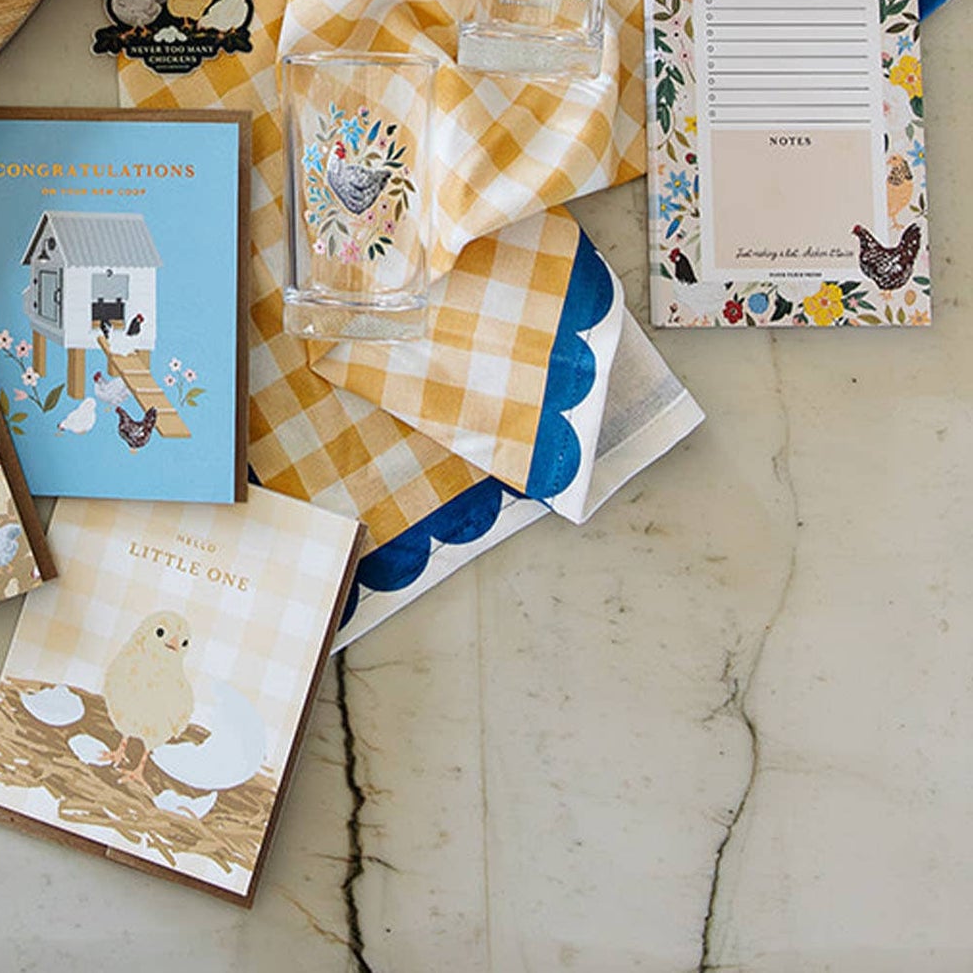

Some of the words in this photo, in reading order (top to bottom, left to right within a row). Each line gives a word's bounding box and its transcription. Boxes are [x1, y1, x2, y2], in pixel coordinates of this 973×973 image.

[131, 46, 161, 54] NEVER
[164, 45, 185, 54] TOO
[187, 45, 214, 53] MANY
[148, 55, 197, 63] CHICKENS
[769, 136, 811, 146] NOTES
[41, 187, 57, 195] ON
[118, 188, 146, 196] COOP
[176, 534, 217, 553] HELLO
[129, 541, 201, 576] LITTLE
[207, 567, 250, 592] ONE
